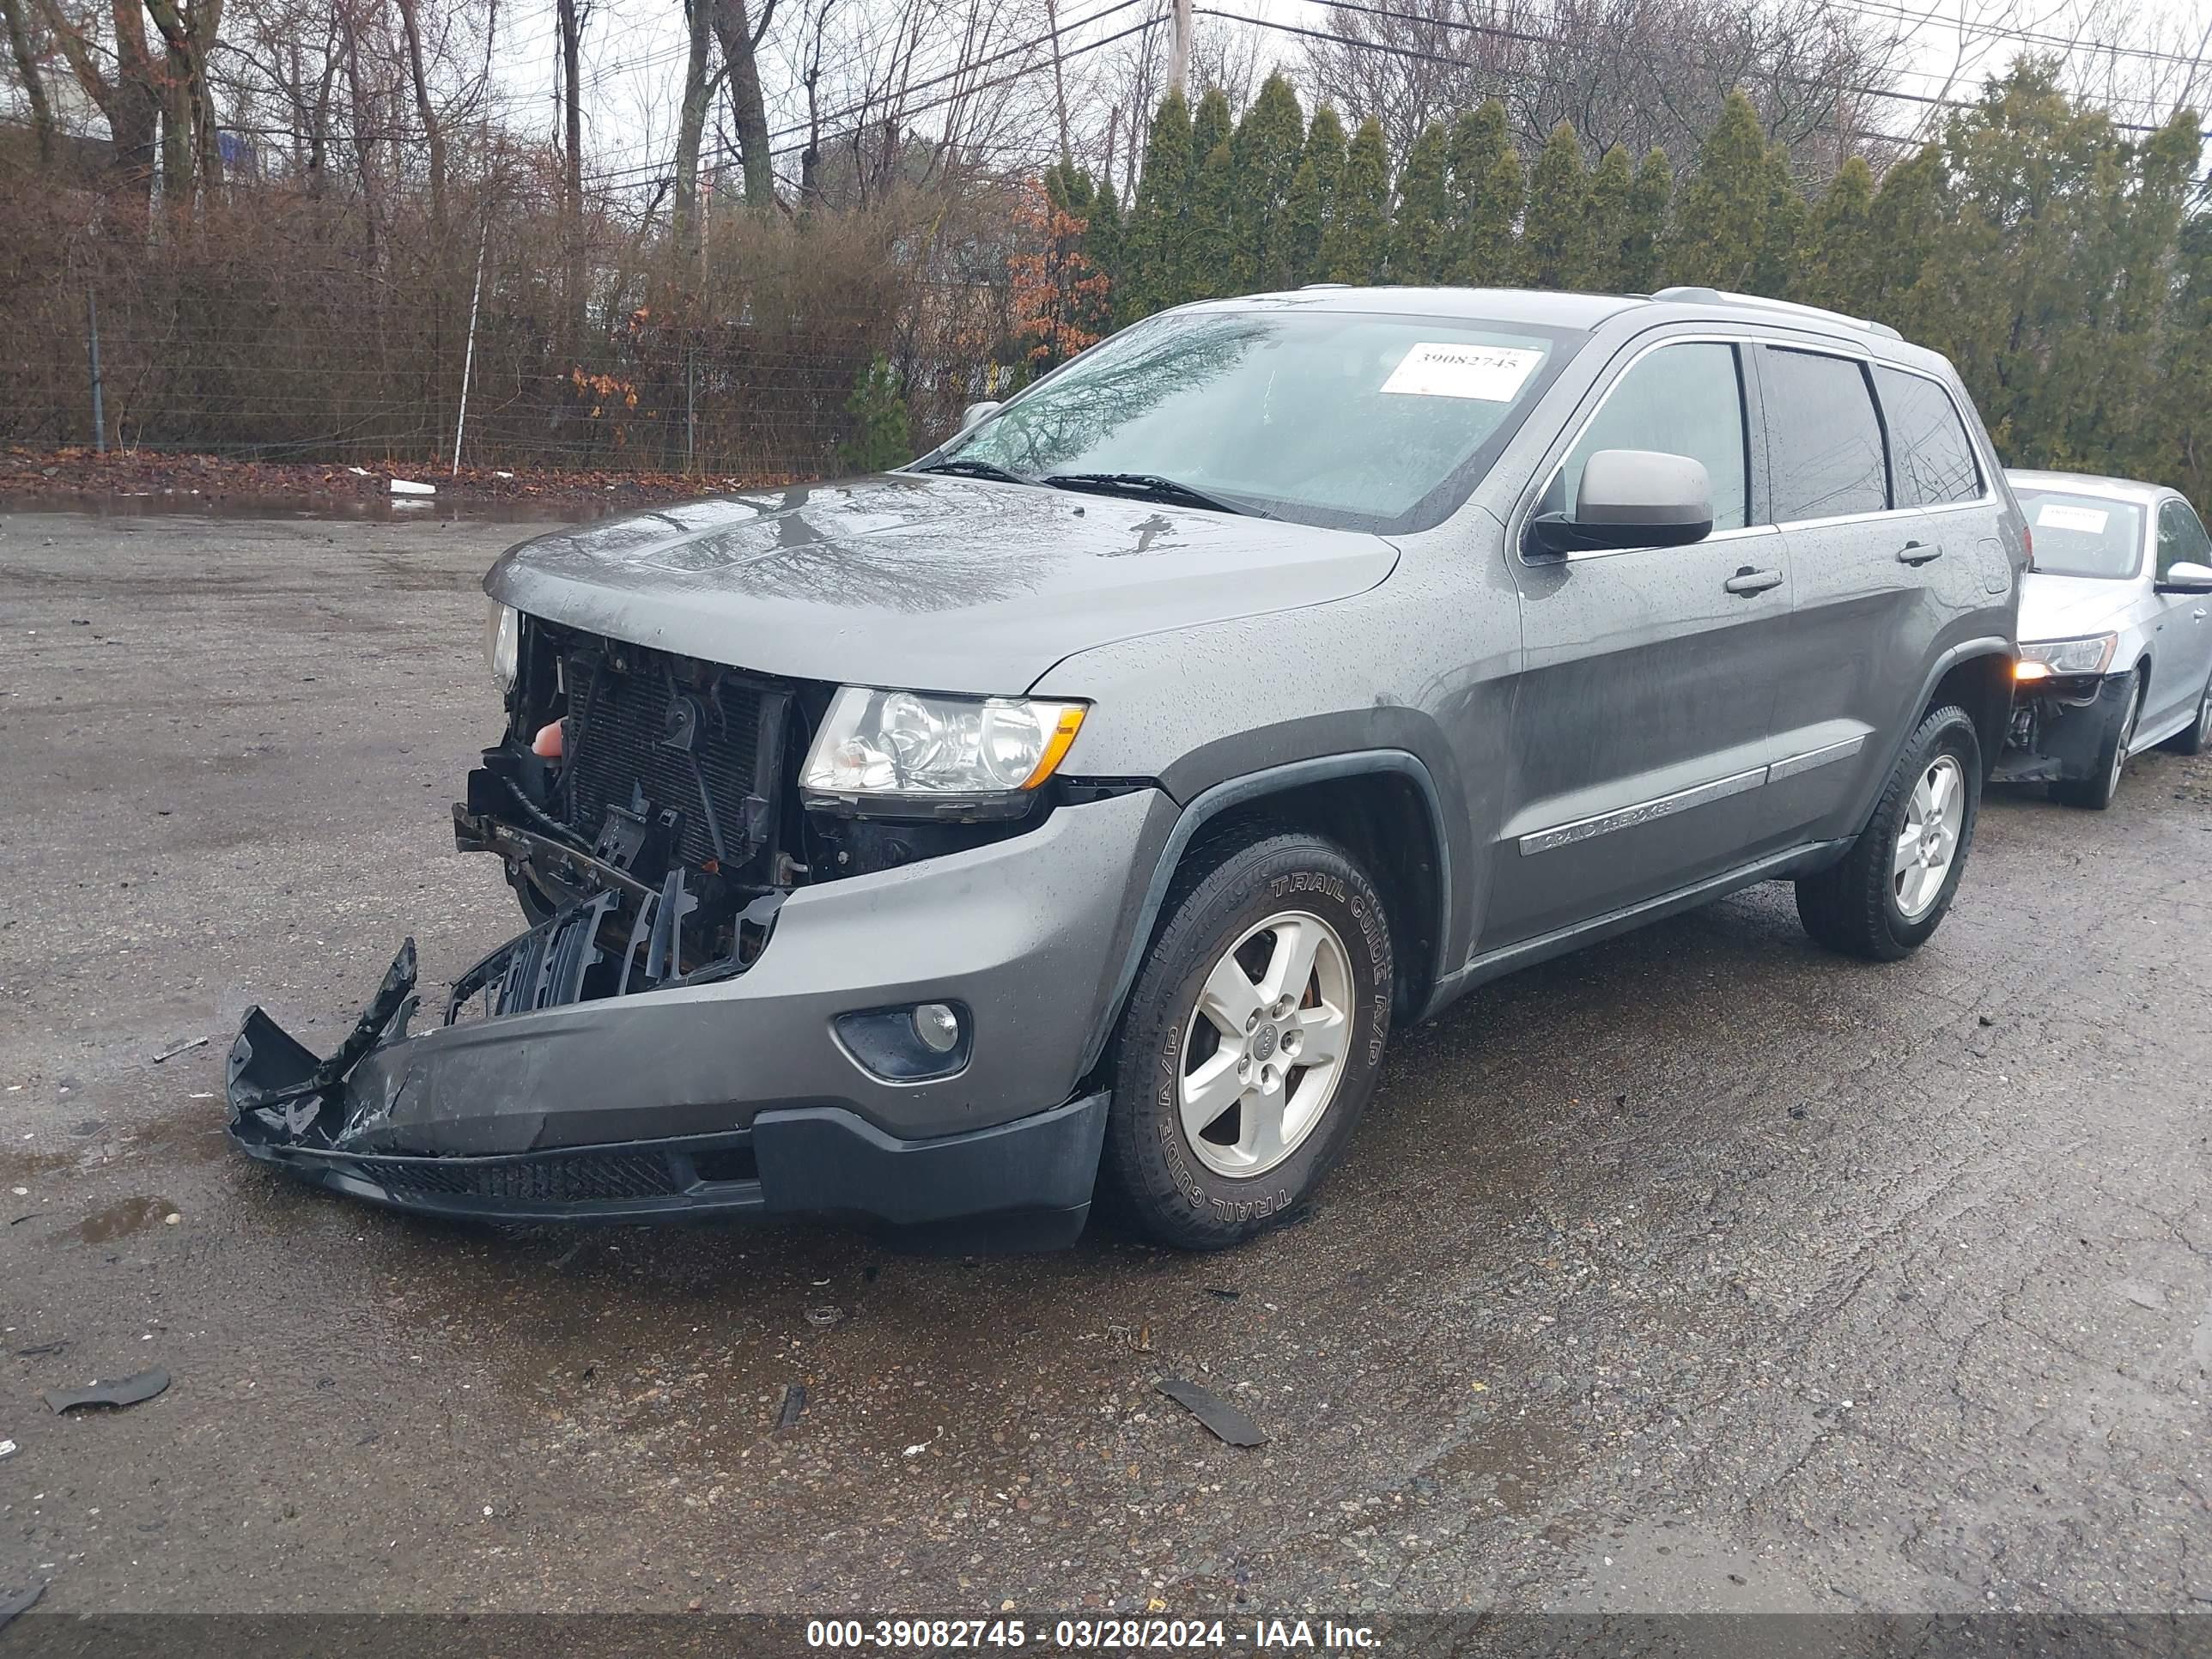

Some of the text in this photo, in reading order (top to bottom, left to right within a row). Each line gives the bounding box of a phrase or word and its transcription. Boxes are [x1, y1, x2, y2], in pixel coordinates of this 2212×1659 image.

[1418, 353, 1519, 368] 39082745
[1544, 824, 1596, 849] GRAND
[1270, 871, 1388, 1066] TRAIL GUIDE A/P
[1158, 1026, 1292, 1222] TRAIL GUIDE A/P
